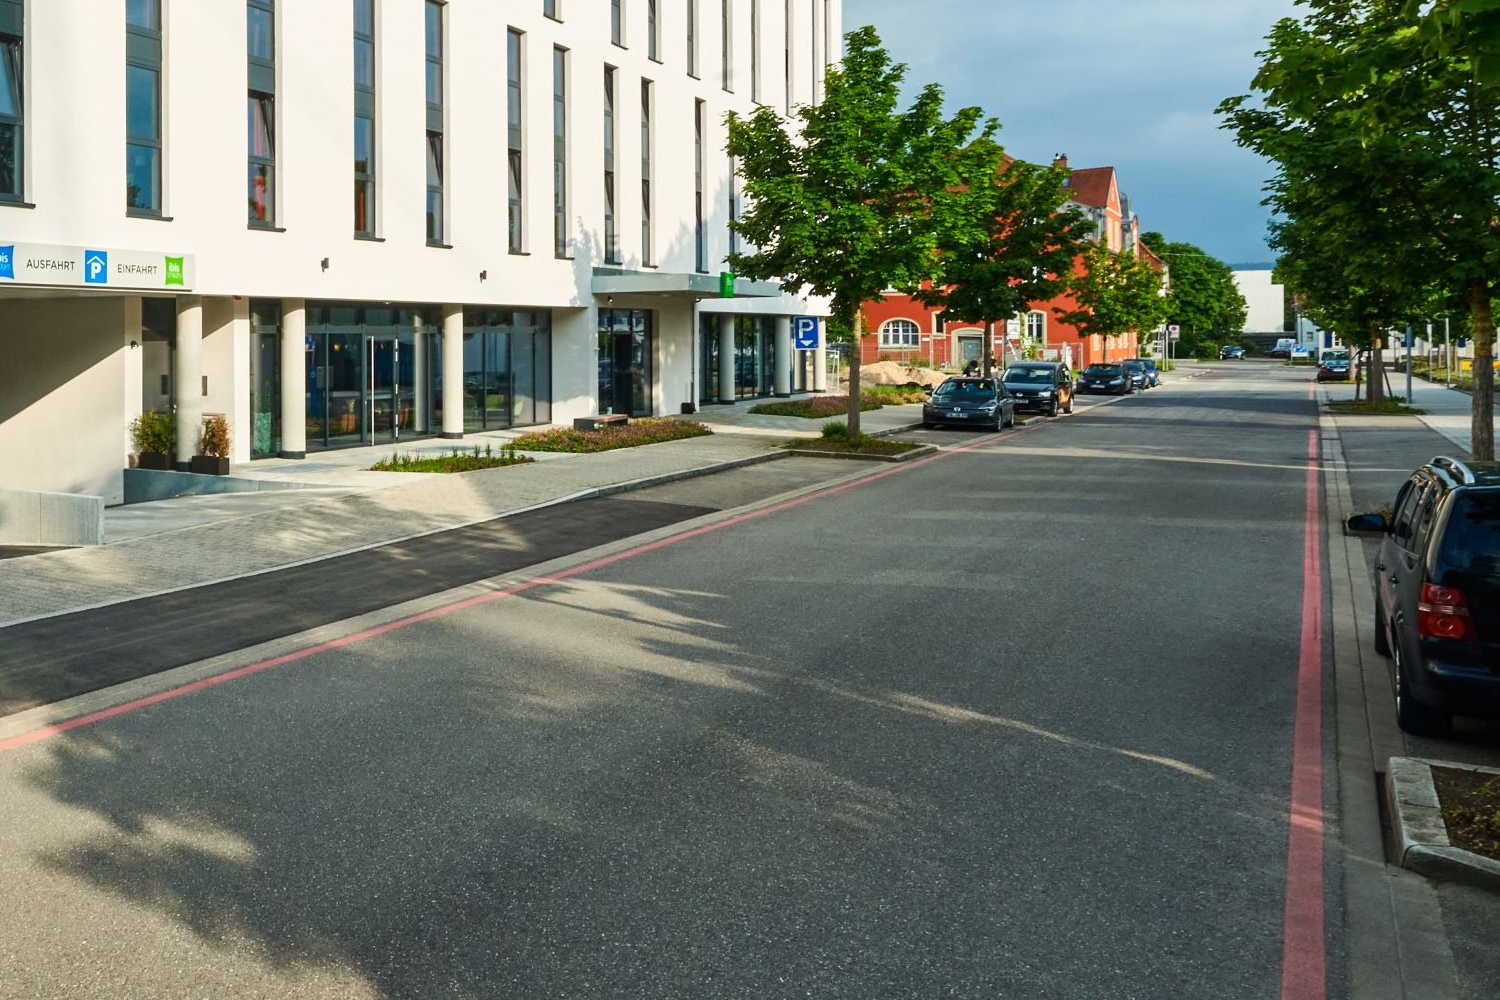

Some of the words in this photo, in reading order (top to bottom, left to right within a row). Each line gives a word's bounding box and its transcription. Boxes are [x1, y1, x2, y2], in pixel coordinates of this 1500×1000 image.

[26, 259, 76, 271] AUSFAHRT
[91, 261, 102, 280] P
[117, 263, 158, 275] EINFAHRT
[798, 319, 814, 339] P
